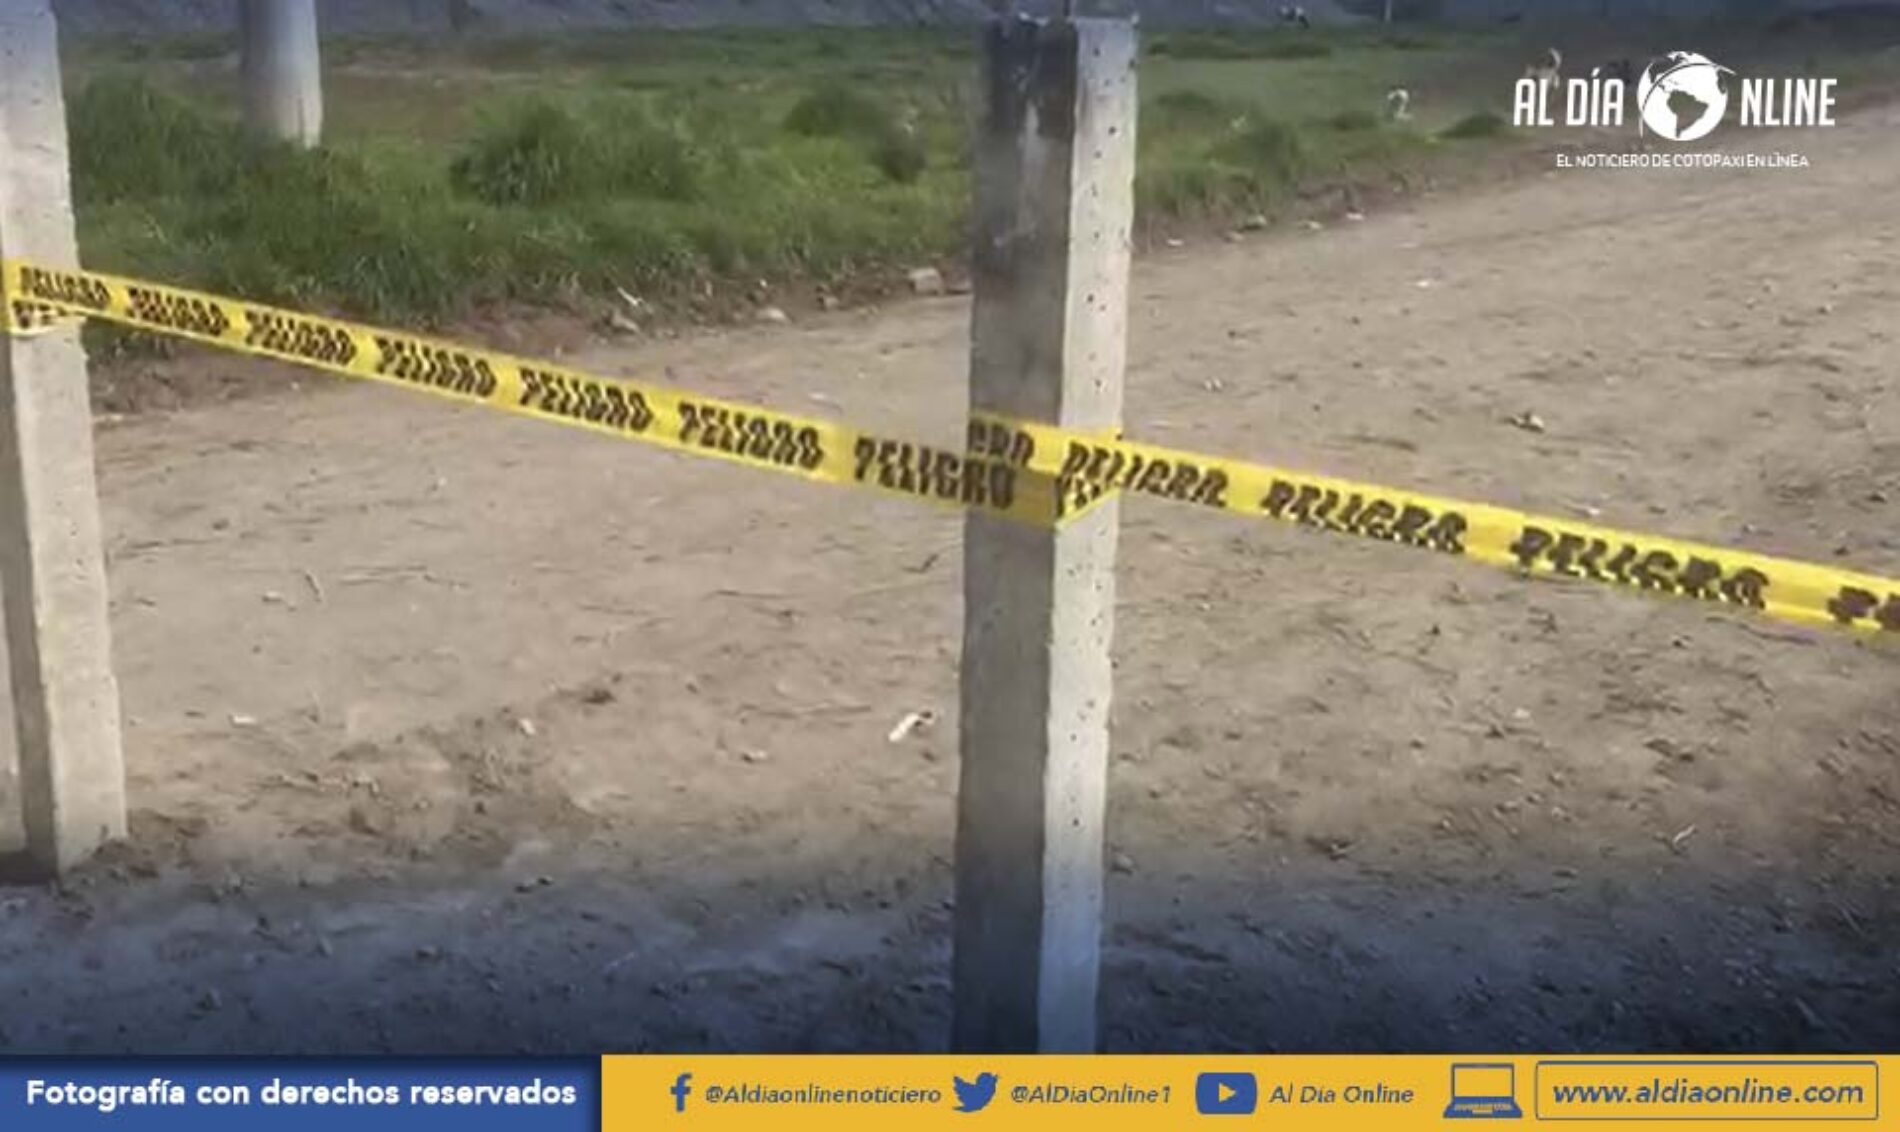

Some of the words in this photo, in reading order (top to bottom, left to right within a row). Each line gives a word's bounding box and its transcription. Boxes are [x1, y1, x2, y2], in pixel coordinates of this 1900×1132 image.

[125, 285, 231, 337] PELIGRO
[244, 308, 358, 367] PELIGRO
[375, 336, 498, 399] PELIGRO
[518, 366, 655, 433] PELIGRO
[677, 401, 827, 472] PELIGRO
[854, 436, 1016, 510] PELIGRO
[1510, 526, 1769, 612] PELIGRO
